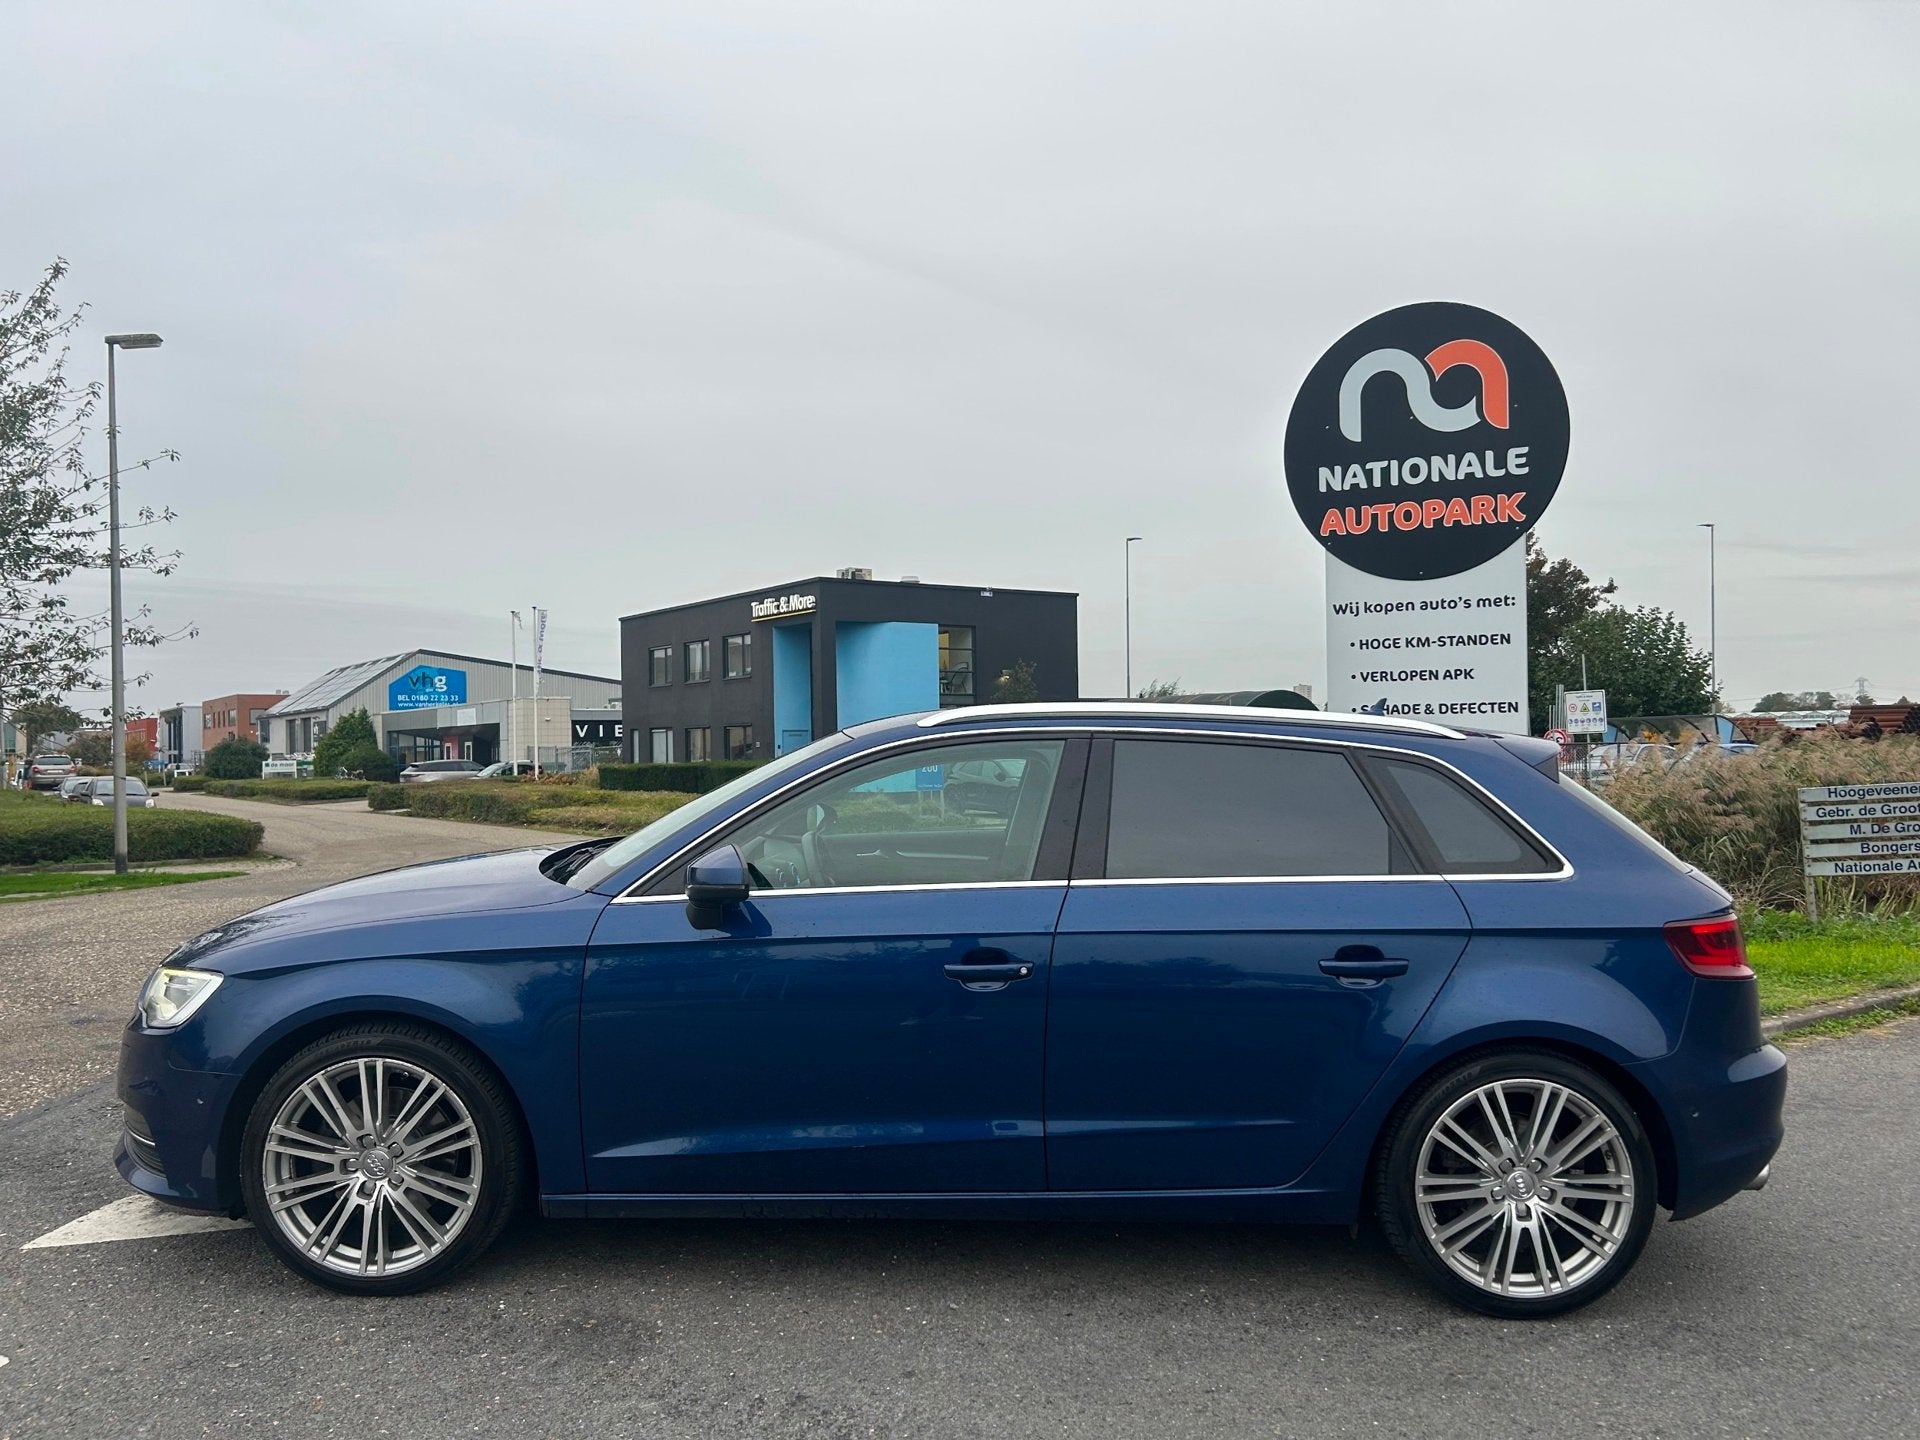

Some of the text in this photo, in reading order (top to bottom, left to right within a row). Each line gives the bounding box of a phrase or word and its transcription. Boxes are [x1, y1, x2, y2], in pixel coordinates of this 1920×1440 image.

[1318, 446, 1530, 493] NATIONALE
[1320, 492, 1526, 536] AUTOPARK
[751, 594, 816, 617] Traffic & More
[1333, 602, 1360, 617] Wij
[1364, 601, 1415, 615] kopen
[1476, 594, 1516, 608] met:
[1359, 633, 1511, 651] HOGE KM-STANDEN
[408, 672, 447, 692] vhg
[1360, 668, 1475, 683] VERLOPEN APK
[1360, 701, 1519, 715] SHADE & DEFECTEN
[575, 724, 623, 738] VIE
[1816, 807, 1854, 818] Gebr.
[1858, 805, 1877, 816] de
[1849, 824, 1866, 835] M.
[1871, 823, 1891, 834] De
[1860, 842, 1920, 854] Bongers
[1834, 860, 1904, 873] Nationale
